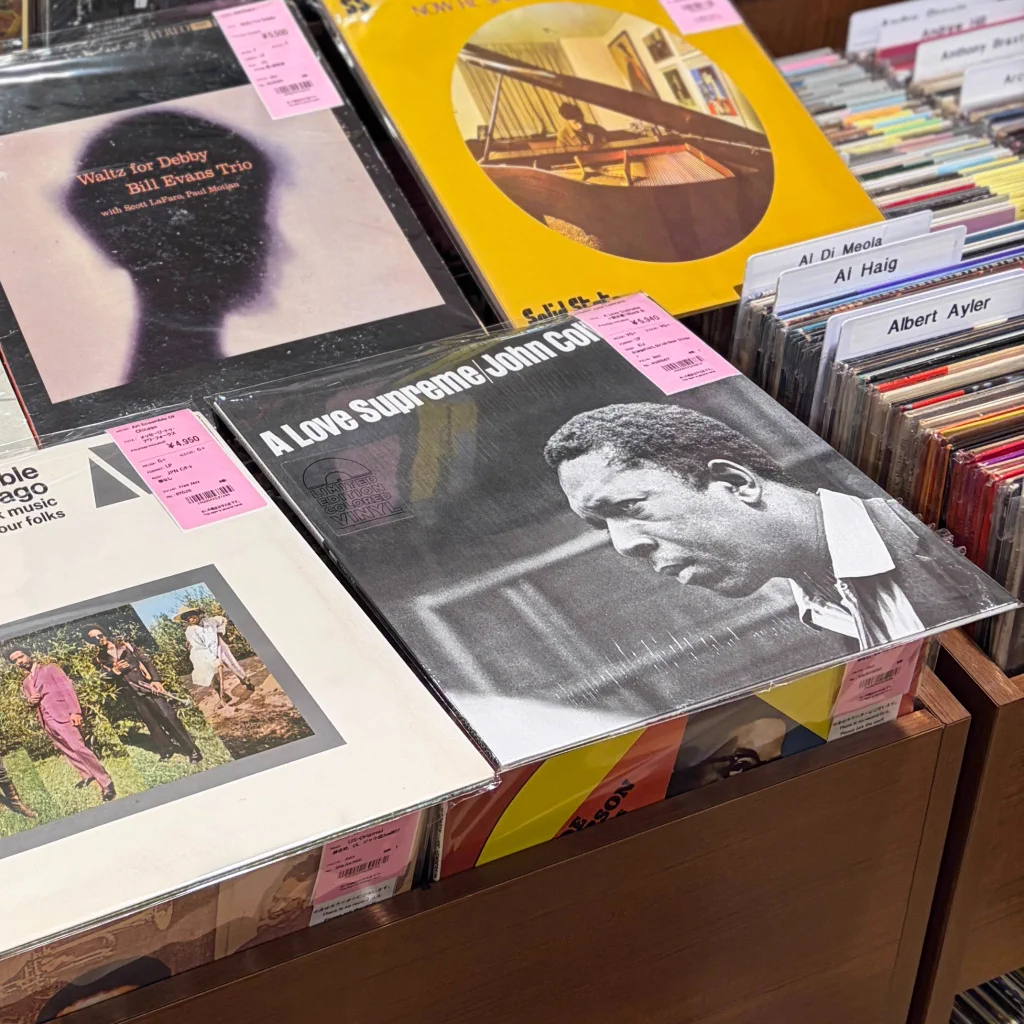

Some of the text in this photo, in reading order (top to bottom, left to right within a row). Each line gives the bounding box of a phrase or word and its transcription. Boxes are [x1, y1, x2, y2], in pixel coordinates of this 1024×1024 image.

[411, 0, 454, 18] NOW
[941, 34, 1024, 62] Anthony Braxt
[77, 149, 209, 186] Waltz for Debby
[126, 160, 253, 195] Bill Evans Trio
[100, 207, 123, 218] with
[124, 201, 148, 212] Scott
[150, 193, 185, 206] LaFaro,
[186, 188, 207, 198] Paul
[799, 237, 883, 267] Al Di Meola
[834, 257, 898, 284] Al Haig
[887, 297, 991, 335] Albert Ayler
[166, 435, 200, 449] ¥4,950
[259, 427, 295, 458] A
[281, 409, 360, 449] Love
[309, 476, 377, 499] LIMITED
[317, 484, 387, 507] EDITION
[7, 496, 58, 519] music
[324, 492, 391, 514] COLORED
[330, 502, 405, 526] VINYL
[25, 508, 67, 527] folks
